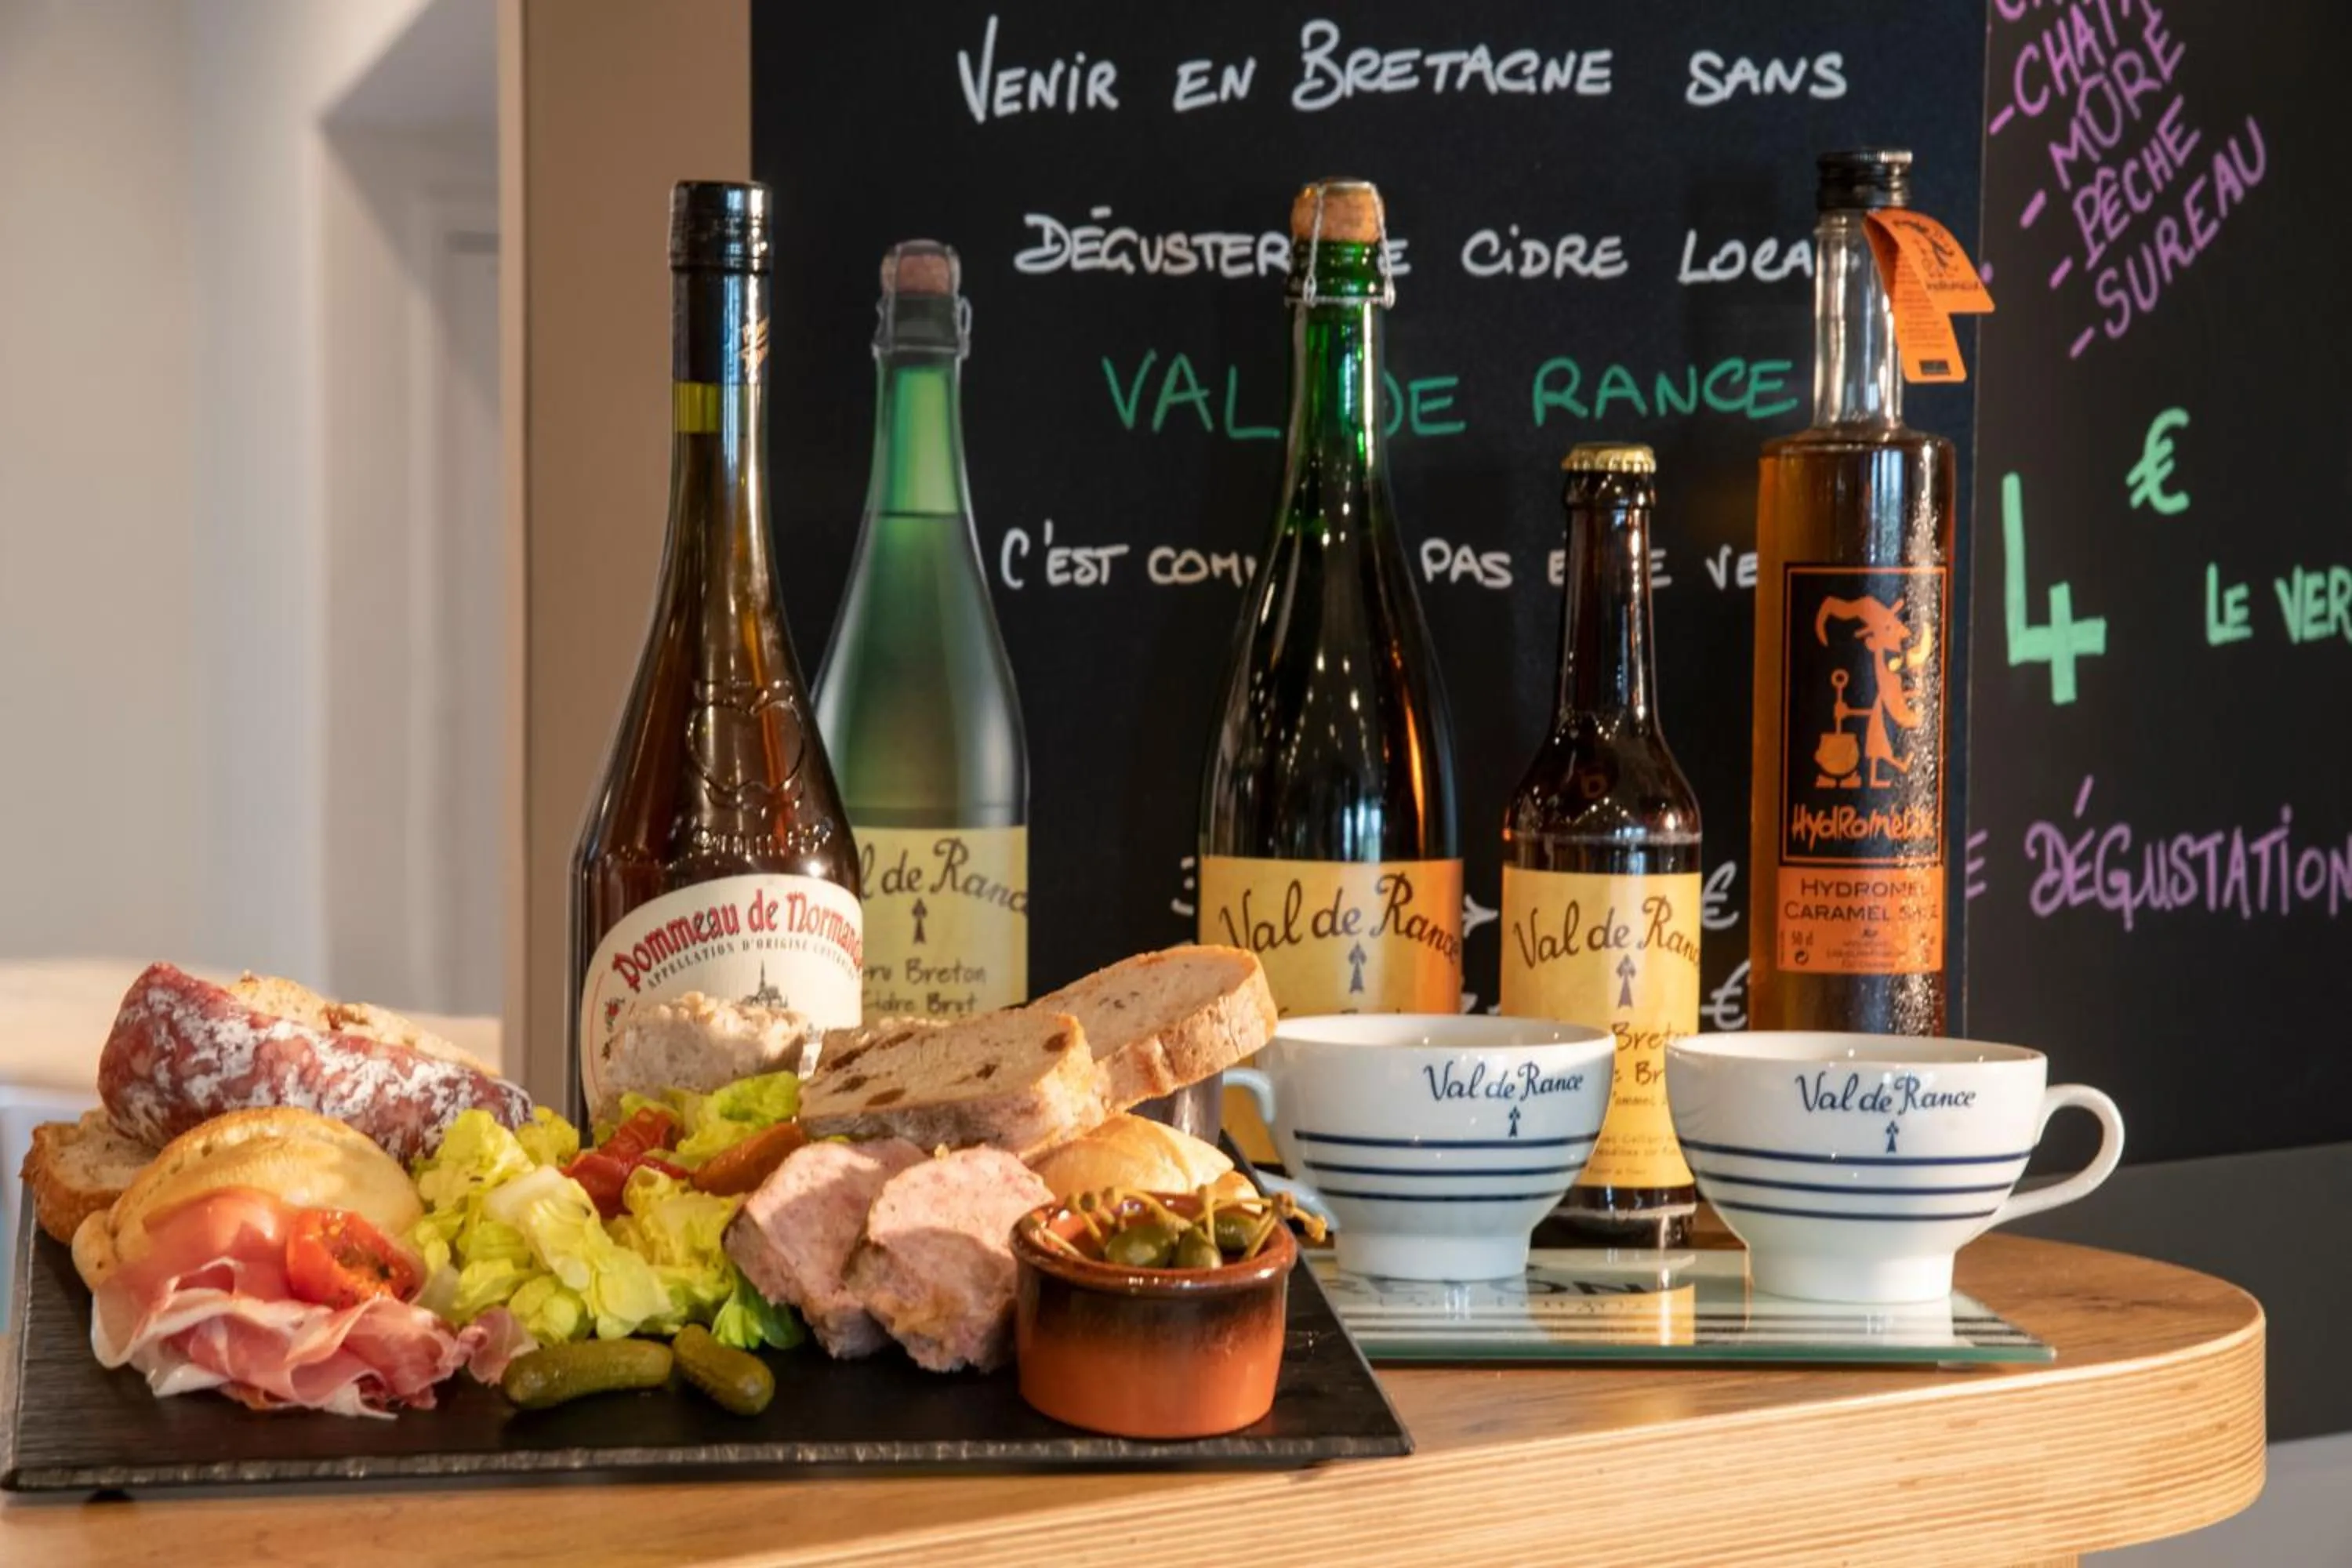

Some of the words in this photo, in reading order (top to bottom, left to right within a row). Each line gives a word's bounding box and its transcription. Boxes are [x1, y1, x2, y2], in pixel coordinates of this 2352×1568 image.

[1174, 57, 1256, 111] EN
[1292, 19, 1613, 112] BRETAGNE
[1686, 50, 1848, 107] SANS
[1677, 230, 1813, 284] LOCA
[2095, 114, 2267, 339] SUREAU
[1102, 349, 1281, 439] VAL
[1531, 357, 1799, 427] RANCE
[1420, 538, 1513, 588] PAS
[2002, 471, 2107, 706] 4
[2125, 407, 2190, 515] €
[2205, 561, 2253, 646] LE
[2274, 564, 2352, 646] VER
[747, 888, 779, 935] de
[880, 848, 923, 896] de
[928, 837, 1028, 916] Ranc
[1784, 900, 1891, 923] CARAMEL
[1219, 878, 1303, 953] Val
[1311, 887, 1362, 938] de
[1514, 899, 1581, 970] Val
[1586, 906, 1630, 953] de
[905, 956, 987, 985] Breton
[1423, 1059, 1486, 1102] Val
[1485, 1069, 1515, 1099] de
[1517, 1060, 1584, 1101] Rance
[1795, 1070, 1859, 1112] Val
[1858, 1083, 1893, 1113] de
[1893, 1073, 1976, 1116] Rance
